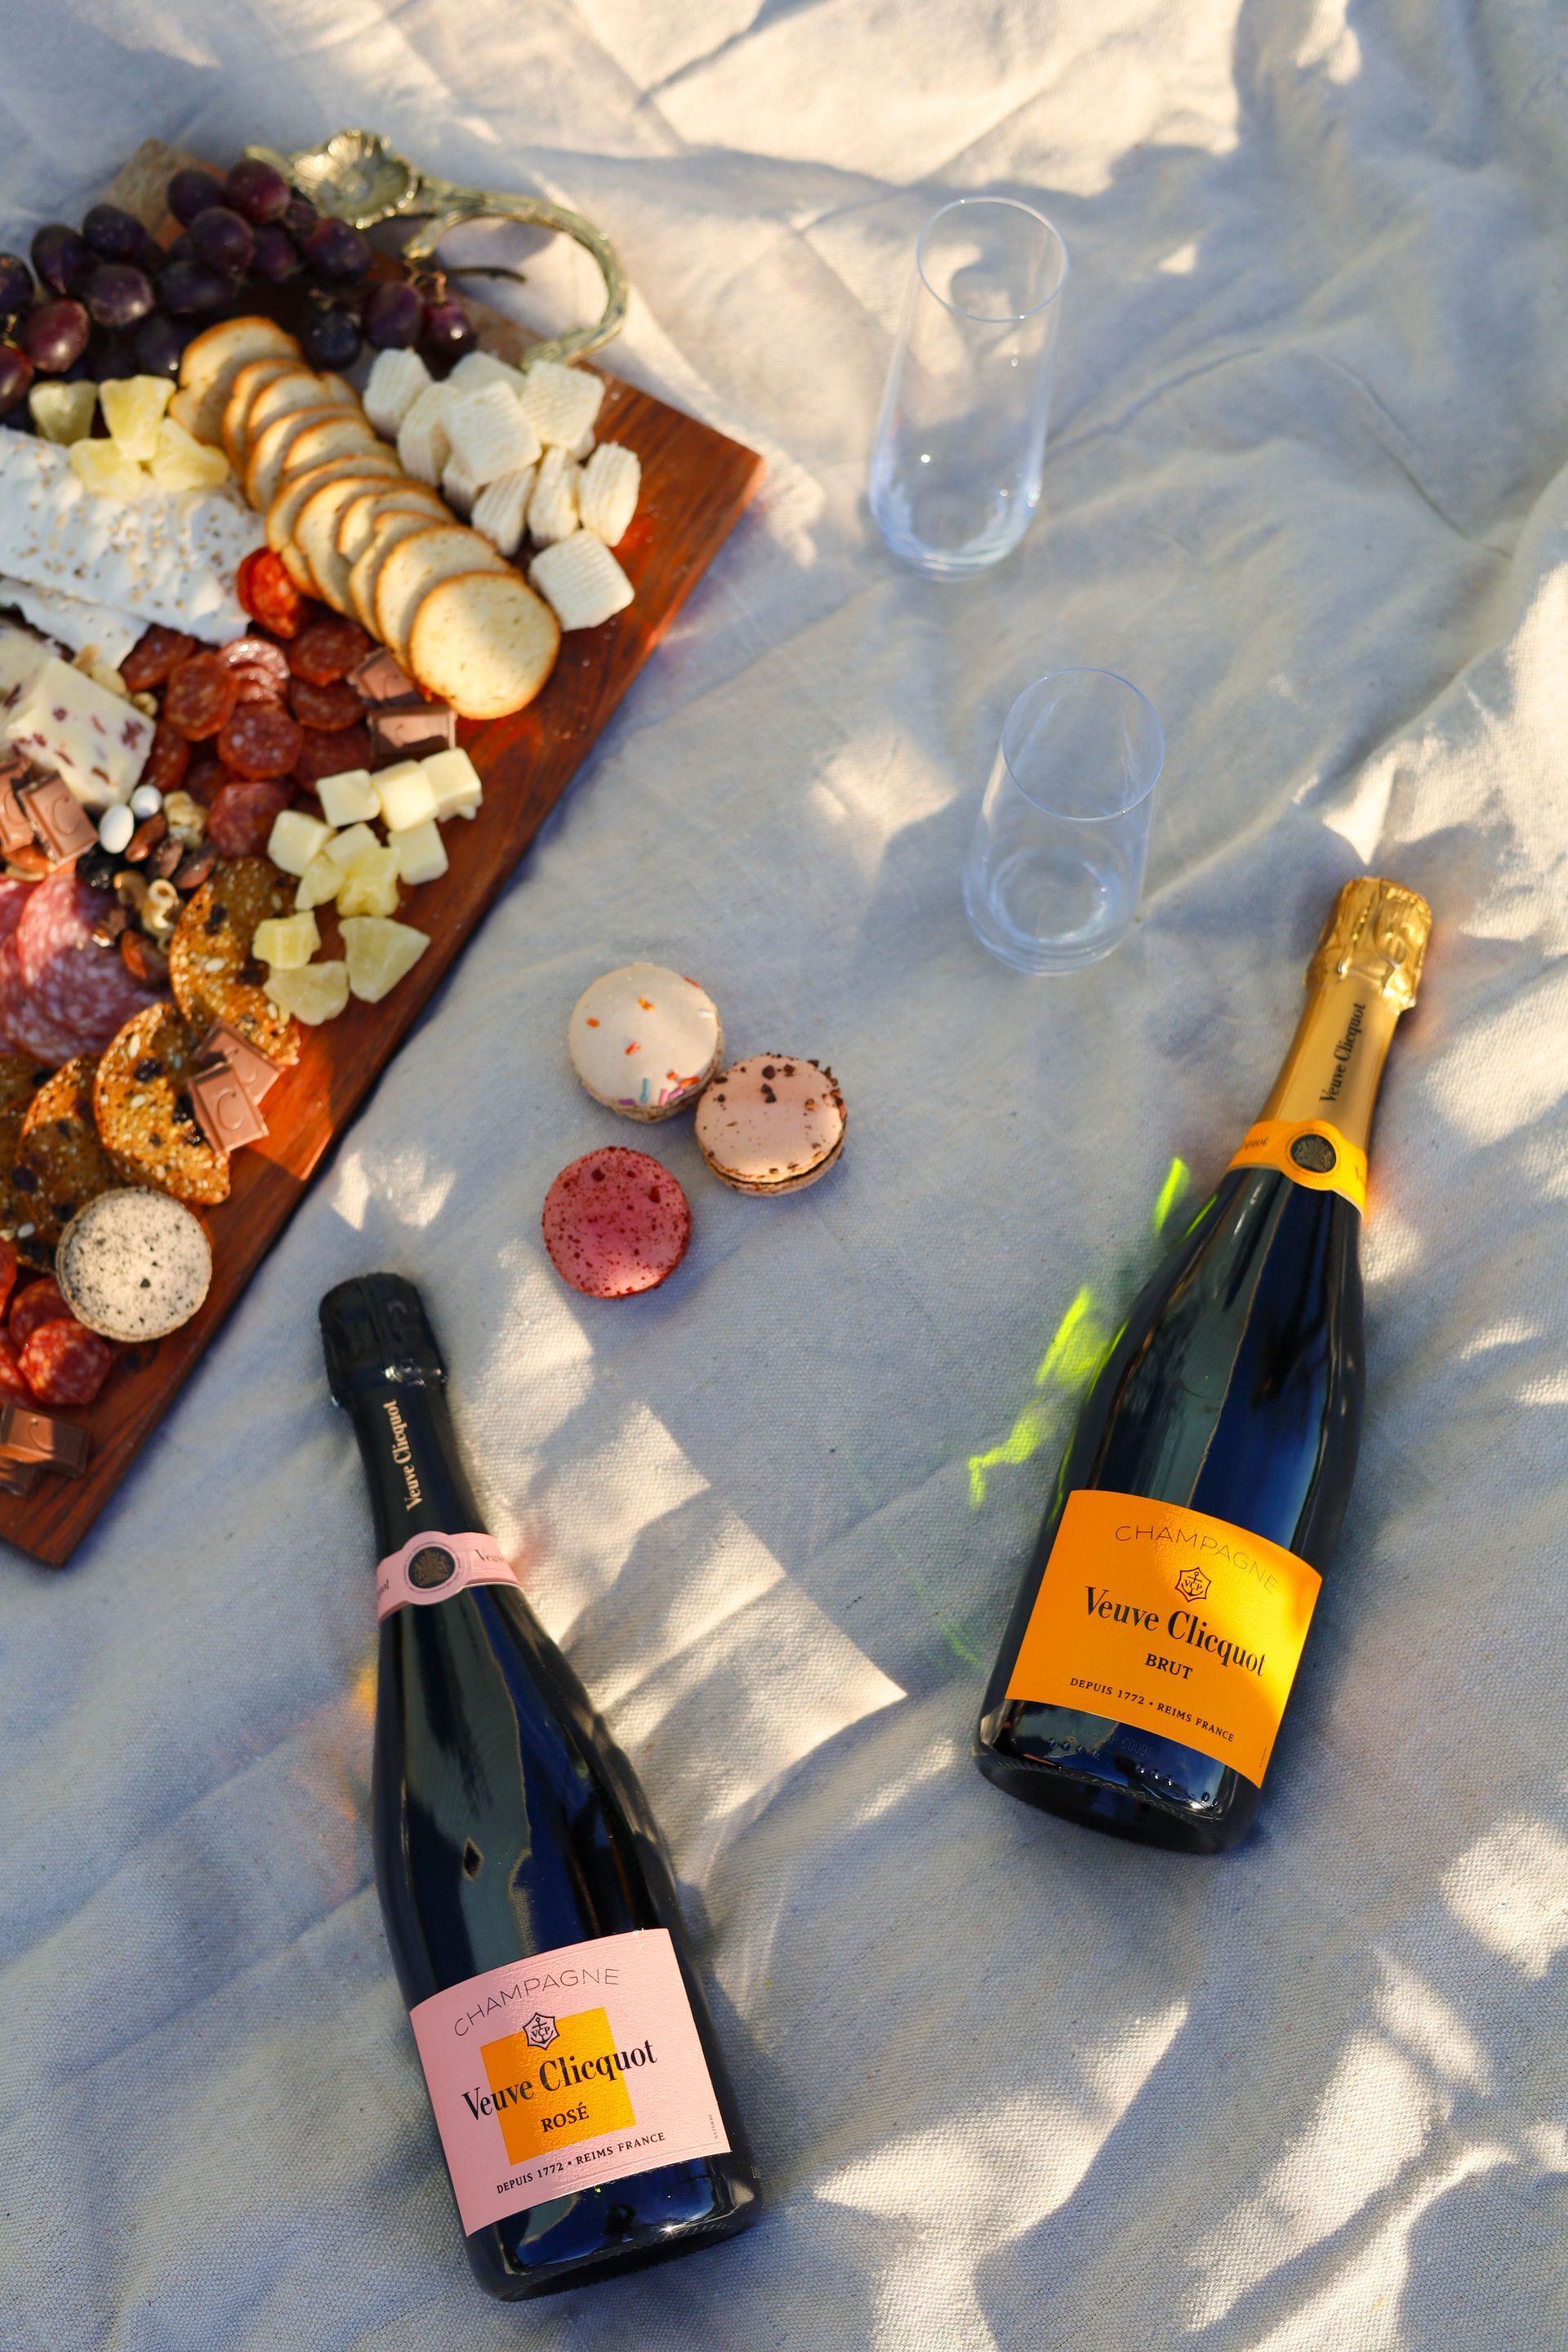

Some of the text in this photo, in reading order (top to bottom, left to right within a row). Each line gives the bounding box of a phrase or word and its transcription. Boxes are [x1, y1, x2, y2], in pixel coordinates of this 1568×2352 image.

[1318, 1003, 1365, 1102] Veuve Clicquot
[383, 1398, 423, 1511] Veuve Clicquot
[1115, 1524, 1279, 1595] CHAMPAGNE
[1085, 1586, 1267, 1677] Veuve Clicquot
[1144, 1653, 1193, 1680] BRUT
[1070, 1677, 1235, 1743] DEPUIS 1772 REIMS FRANCE
[454, 1968, 620, 2037] CHAMPAGNE
[461, 2040, 658, 2121] Veuve Clicquot
[541, 2101, 590, 2133] ROSÉ
[497, 2132, 666, 2194] DEPUIS 1772 REIMS FRANCE
